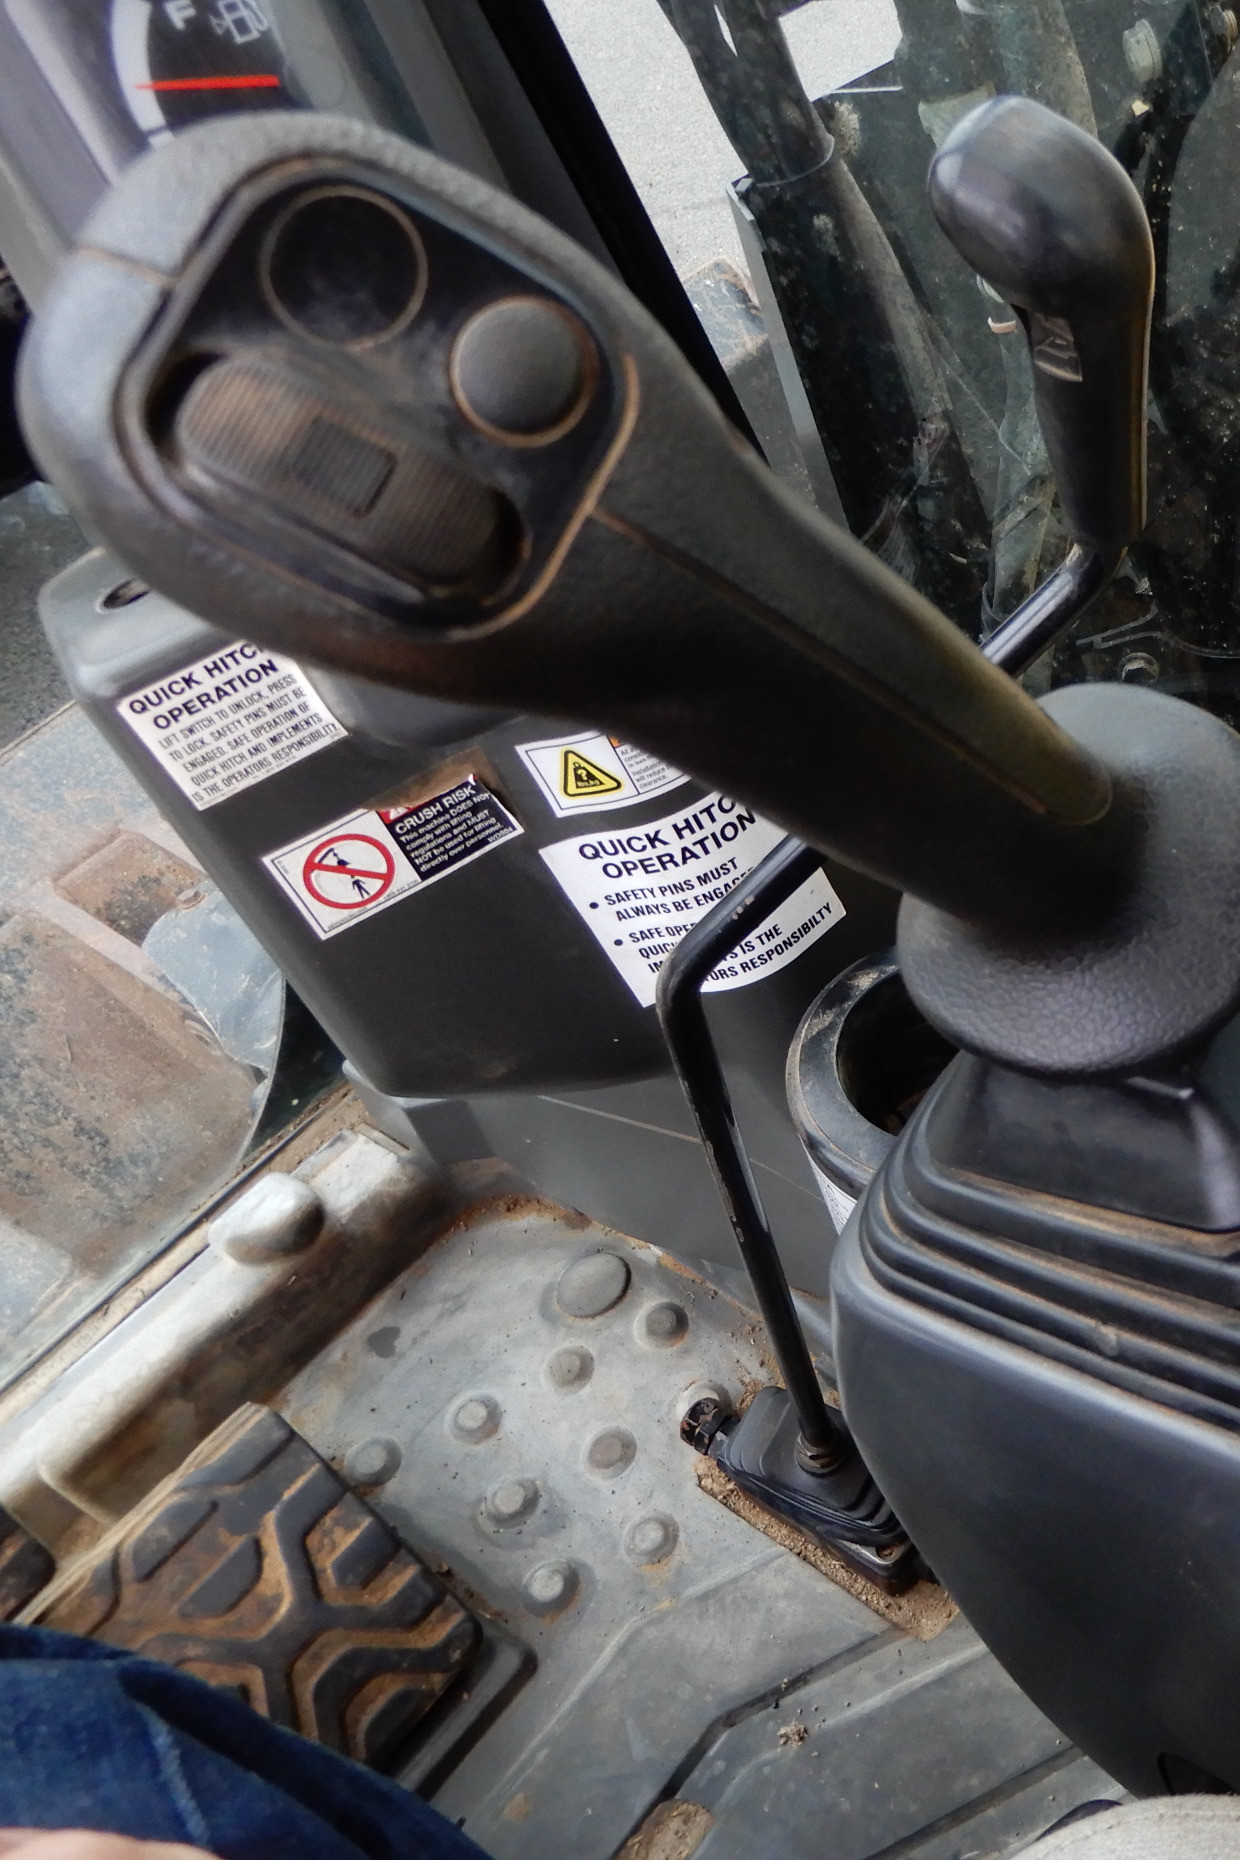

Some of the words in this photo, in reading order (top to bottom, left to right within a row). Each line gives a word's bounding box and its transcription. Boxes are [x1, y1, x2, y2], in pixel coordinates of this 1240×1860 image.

[129, 671, 201, 714] QUICK
[203, 643, 265, 678] HITC
[153, 659, 278, 729] OPERATION
[158, 733, 180, 749] LIFT
[180, 715, 216, 739] SWITCH
[214, 709, 229, 721] TO
[267, 673, 297, 694] PRESS
[168, 750, 184, 762] TO
[210, 719, 244, 741] SAFETY
[243, 707, 267, 725] PINS
[266, 693, 293, 713] MUST
[292, 687, 307, 700] BE
[227, 734, 252, 751] SAFE
[250, 708, 299, 739] OPERATION
[297, 701, 312, 714] OF
[190, 766, 220, 787] QUICK
[219, 752, 248, 772] HITCH
[247, 742, 267, 758] AND
[267, 713, 323, 748] IMPLEMENTS
[191, 791, 205, 802] IS
[203, 782, 224, 797] THE
[221, 756, 272, 788] OPERATORS
[395, 802, 443, 834] CRUSH
[442, 785, 476, 809] RISK
[399, 832, 418, 844] This
[419, 813, 450, 835] machine
[449, 800, 473, 817] DOES
[473, 793, 491, 804] NOT
[405, 831, 434, 851] comply
[434, 823, 451, 836] with
[450, 811, 473, 828] lifting
[410, 832, 452, 859] regulations
[452, 823, 467, 836] and
[466, 809, 490, 826] MUST
[578, 829, 670, 860] QUICK
[671, 795, 737, 840] HITC
[414, 852, 434, 865] NOT
[433, 846, 445, 856] be
[445, 835, 463, 850] used
[463, 829, 475, 838] for
[474, 817, 497, 833] lifting
[420, 853, 449, 873] directly
[448, 846, 466, 857] over
[602, 809, 757, 879] OPERATION
[604, 886, 655, 906] SAFETY
[658, 878, 695, 897] PINS
[695, 857, 739, 887] MUST
[615, 903, 671, 922] ALWAYS
[674, 898, 694, 912] BE
[628, 926, 667, 944] SAFE
[638, 941, 680, 960] QUIC
[739, 902, 834, 974] RESPONSIBILTY
[741, 939, 757, 955] IS
[755, 923, 783, 946] THE
